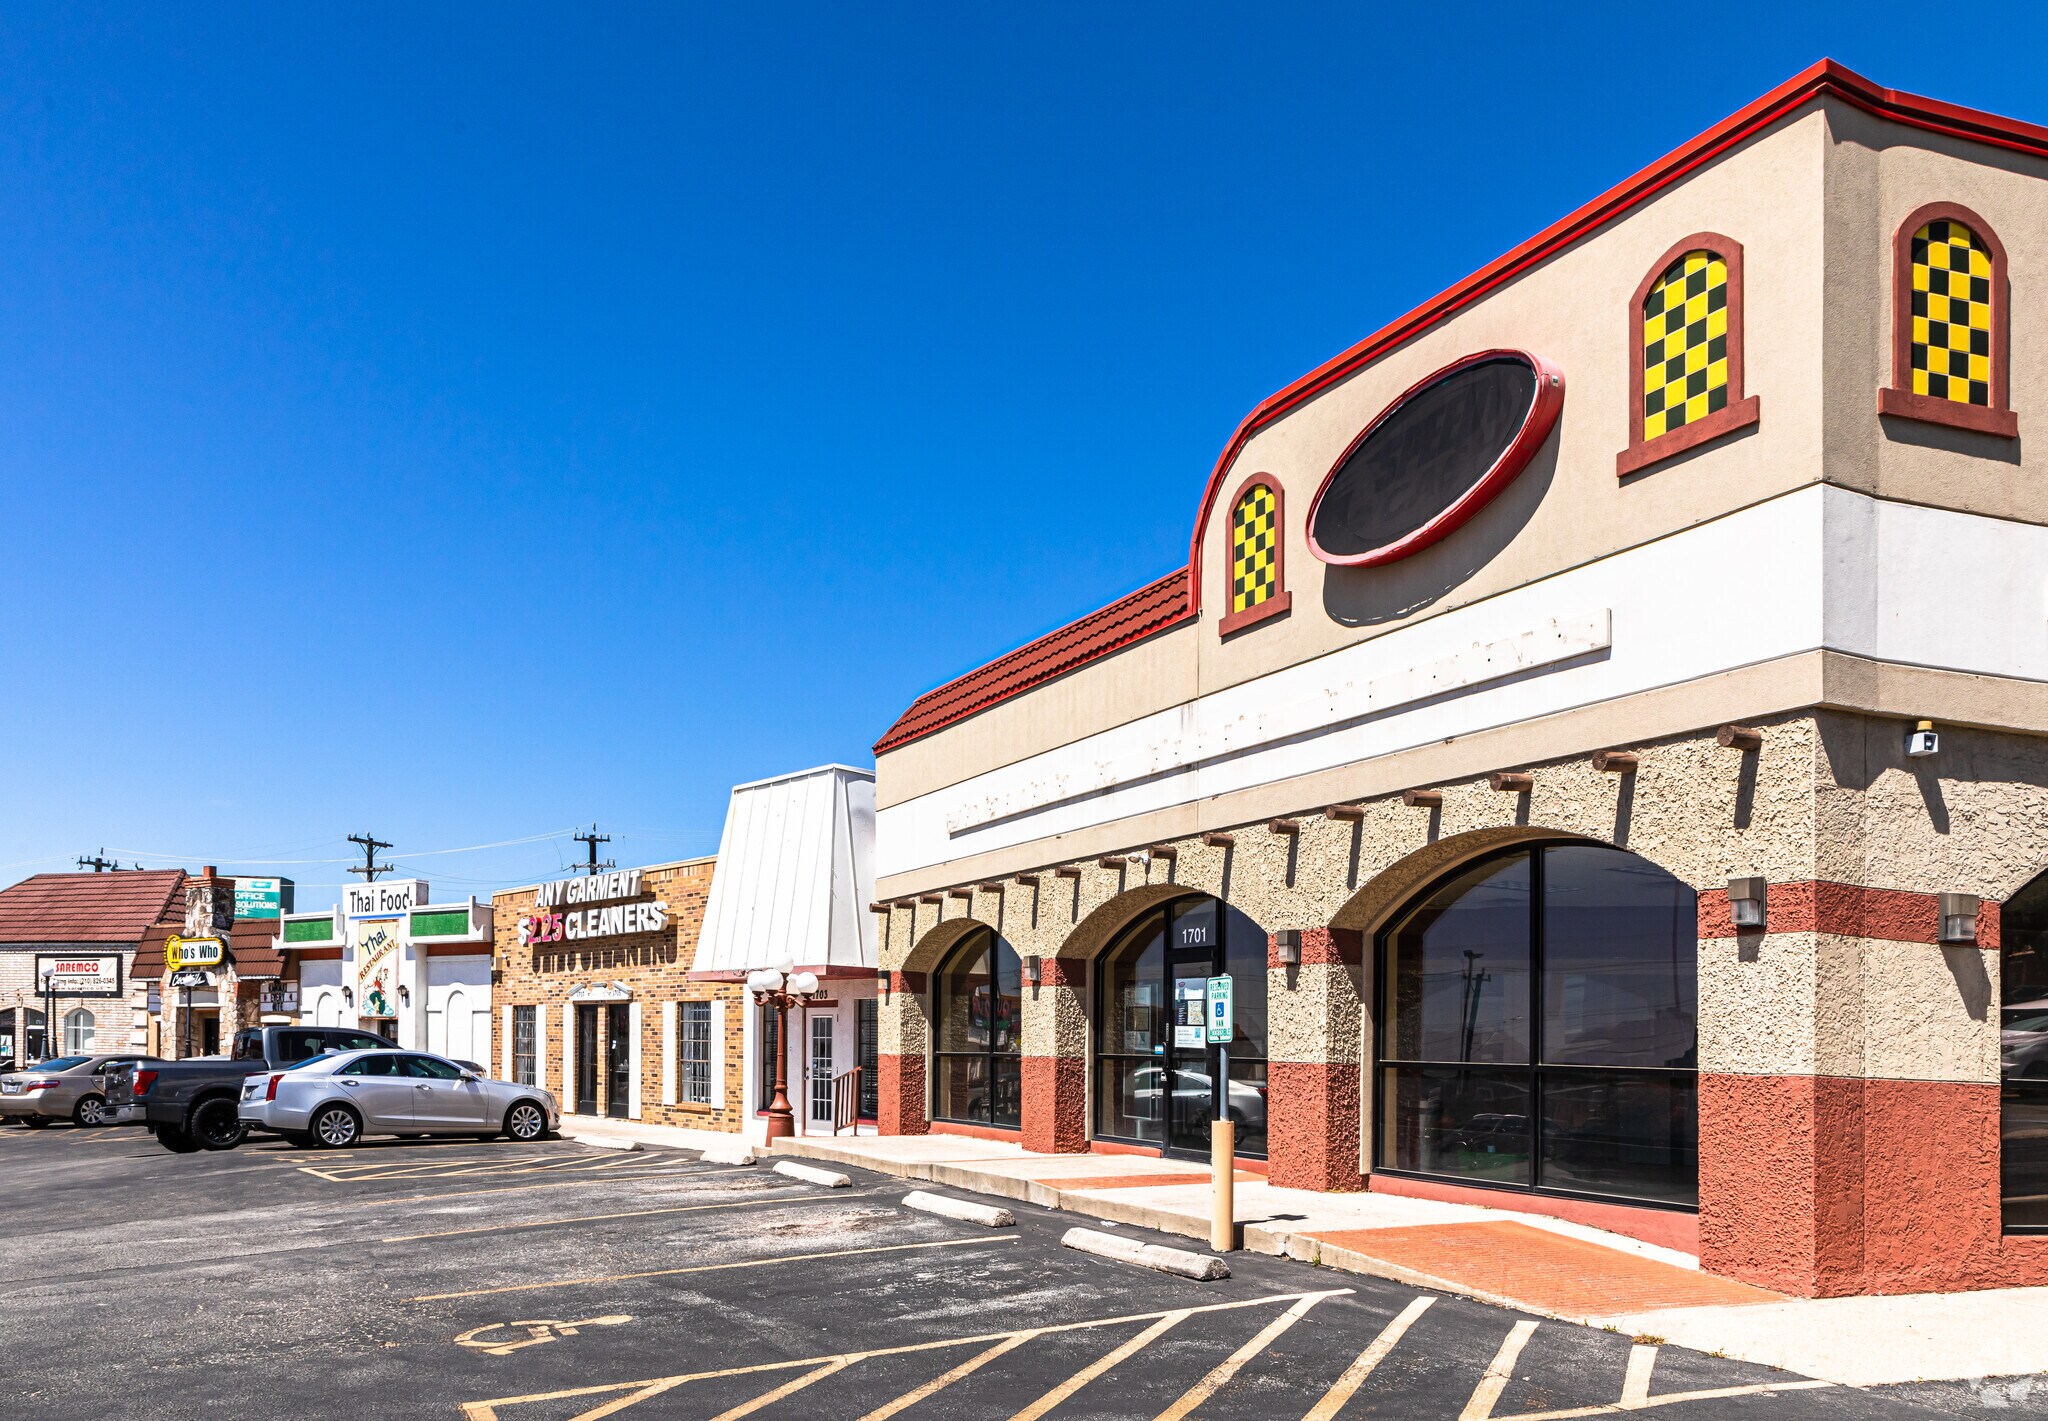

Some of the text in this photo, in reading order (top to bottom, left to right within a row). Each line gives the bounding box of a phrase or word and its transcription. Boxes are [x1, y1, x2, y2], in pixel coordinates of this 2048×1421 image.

[235, 892, 265, 900] OFFICE
[535, 869, 644, 908] ANY GARMENT
[236, 901, 277, 909] SOLUTIONS
[350, 886, 412, 913] Thai Food
[518, 901, 668, 946] $2.25 CLEANERS
[361, 926, 387, 955] Thai
[1182, 927, 1206, 943] 1701
[172, 945, 218, 959] Who's Who
[360, 939, 396, 980] RESTAURANT
[55, 962, 99, 972] SAREMCO
[1210, 982, 1229, 991] RESERVED
[1211, 991, 1228, 999] PARKING
